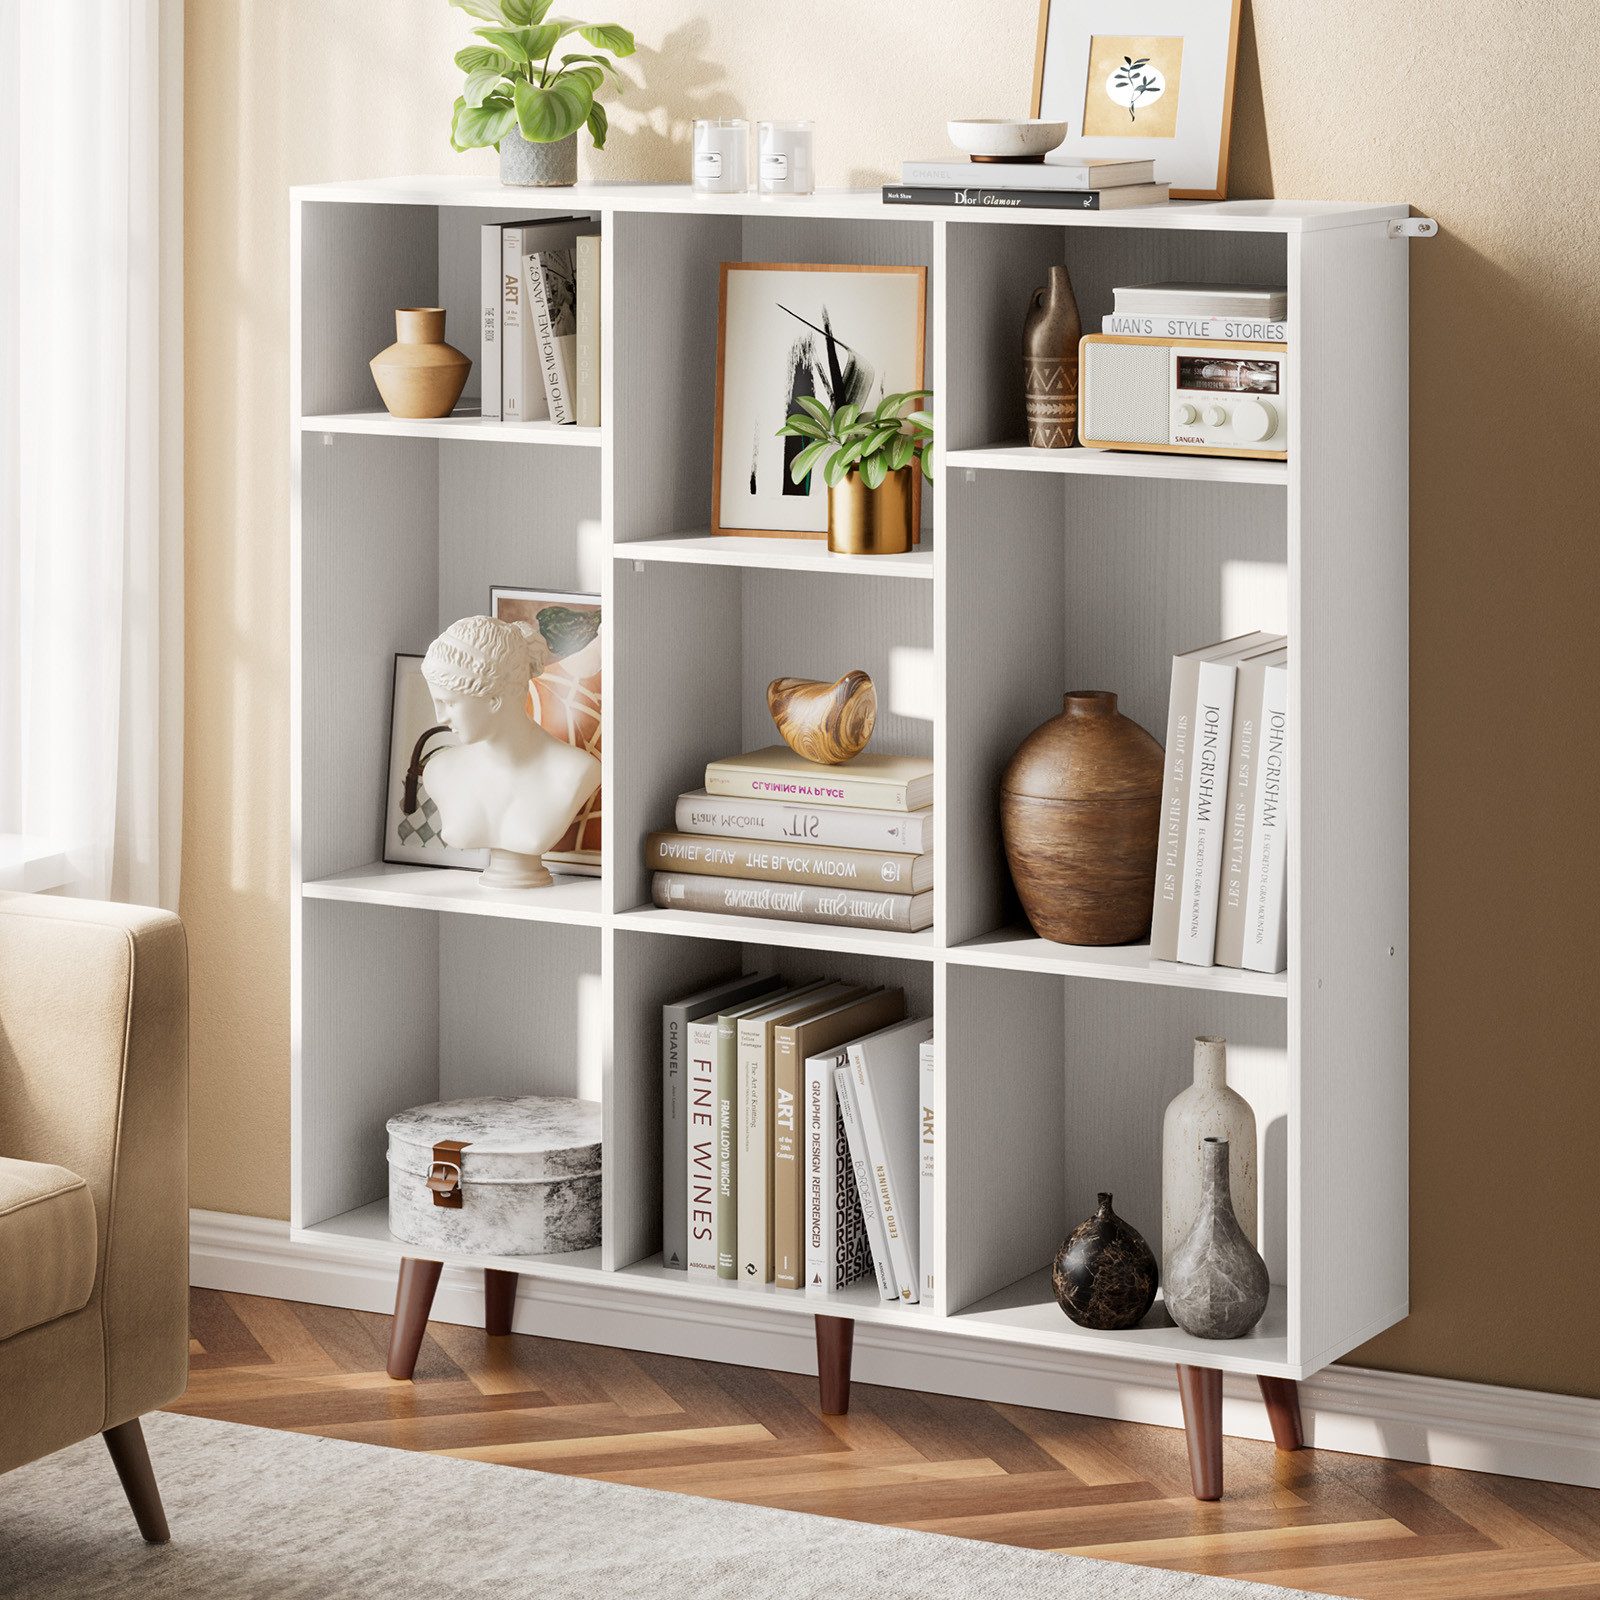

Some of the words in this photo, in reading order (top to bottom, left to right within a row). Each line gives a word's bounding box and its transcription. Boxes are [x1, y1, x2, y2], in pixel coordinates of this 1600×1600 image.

[912, 169, 952, 179] CHANEL
[954, 188, 977, 205] Dior
[983, 195, 1021, 206] Glamour
[505, 274, 519, 305] ART
[530, 266, 545, 307] JANG?
[538, 310, 555, 370] MICHAEL
[1111, 318, 1153, 334] MAN'S
[1168, 321, 1210, 336] STYLE
[1225, 323, 1284, 339] STORIES
[548, 372, 559, 385] IS
[551, 388, 565, 424] WHO
[1176, 715, 1187, 754] JOURS
[1203, 704, 1220, 748] JOHN
[1240, 720, 1253, 759] JOURS
[1268, 709, 1285, 754] JOHN
[1174, 759, 1184, 782] LES
[1197, 750, 1217, 821] GRISHAM
[1239, 764, 1249, 787] LES
[1262, 755, 1282, 827] GRISHAM
[1166, 797, 1180, 867] PLAISIRS
[1231, 803, 1246, 873] PLAISIRS
[1196, 837, 1206, 867] SECRETO
[1261, 842, 1271, 873] SECRETO
[1163, 874, 1175, 901] LES
[1193, 879, 1203, 897] GRAY
[1195, 868, 1203, 878] DE
[1228, 880, 1240, 907] LES
[1190, 898, 1202, 938] MOUNTAIN
[1256, 904, 1267, 944] MOUNTAIN
[669, 1021, 678, 1077] CHANEL
[693, 1059, 712, 1126] FINE
[751, 1090, 758, 1098] of
[777, 1087, 794, 1131] ART
[812, 1080, 821, 1129] GRAPHIC
[720, 1099, 730, 1129] FRANK
[750, 1099, 758, 1128] Knitting
[720, 1131, 730, 1159] LLOYD
[812, 1132, 821, 1173] DESIGN
[693, 1141, 712, 1241] WINES
[720, 1160, 731, 1197] WRIGHT
[854, 1160, 876, 1220] BORDEAUX
[876, 1165, 893, 1213] SAARINEN
[812, 1176, 821, 1248] REFERENCED
[886, 1215, 898, 1239] EERO
[689, 1262, 716, 1270] ASSOULINE
